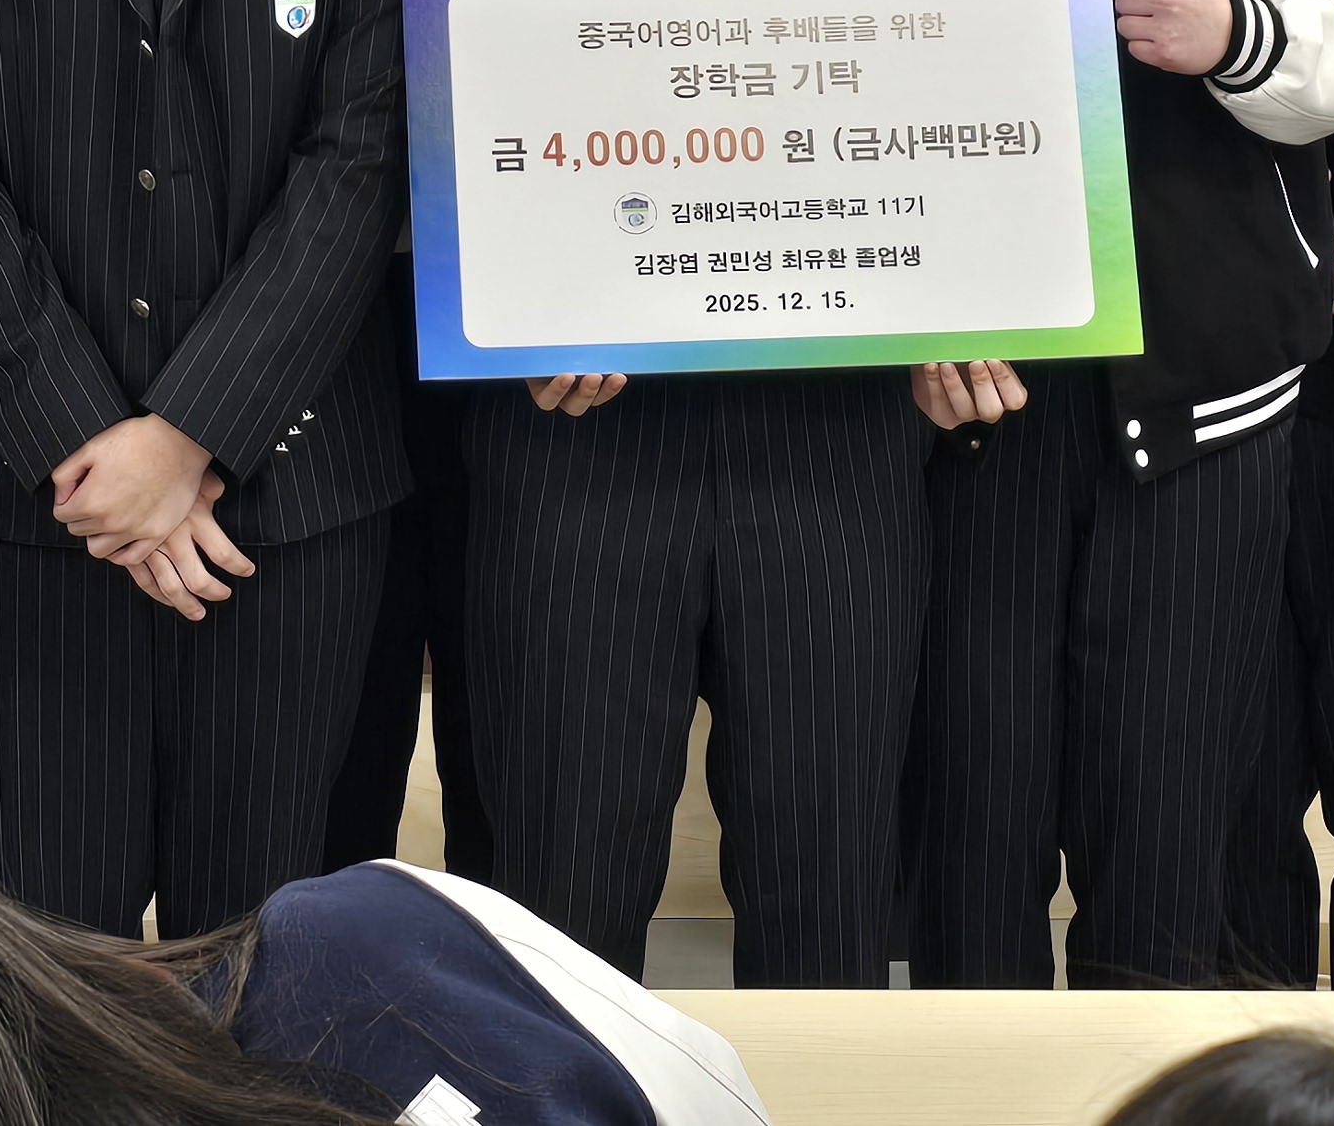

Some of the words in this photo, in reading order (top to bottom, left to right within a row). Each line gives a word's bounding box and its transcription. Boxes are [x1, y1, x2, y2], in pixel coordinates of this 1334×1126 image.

[578, 17, 753, 49] 중국어영어과
[763, 15, 878, 44] 후배들을
[890, 12, 946, 41] 위한
[669, 63, 777, 99] 장학금
[791, 60, 863, 95] 기탁
[492, 137, 527, 172] 금
[542, 126, 765, 172] 4,000,000
[782, 128, 816, 163] 원
[833, 120, 1042, 162] (금사백만원)
[671, 198, 869, 224] 김해외국어고등학교
[877, 195, 925, 217] 11기
[634, 253, 699, 276] 김장엽
[707, 250, 773, 273] 권민성
[782, 247, 848, 271] 최유환
[855, 244, 922, 268] 졸업생
[705, 294, 769, 313] 2025.
[777, 292, 812, 311] 12.
[821, 290, 855, 309] 15.
